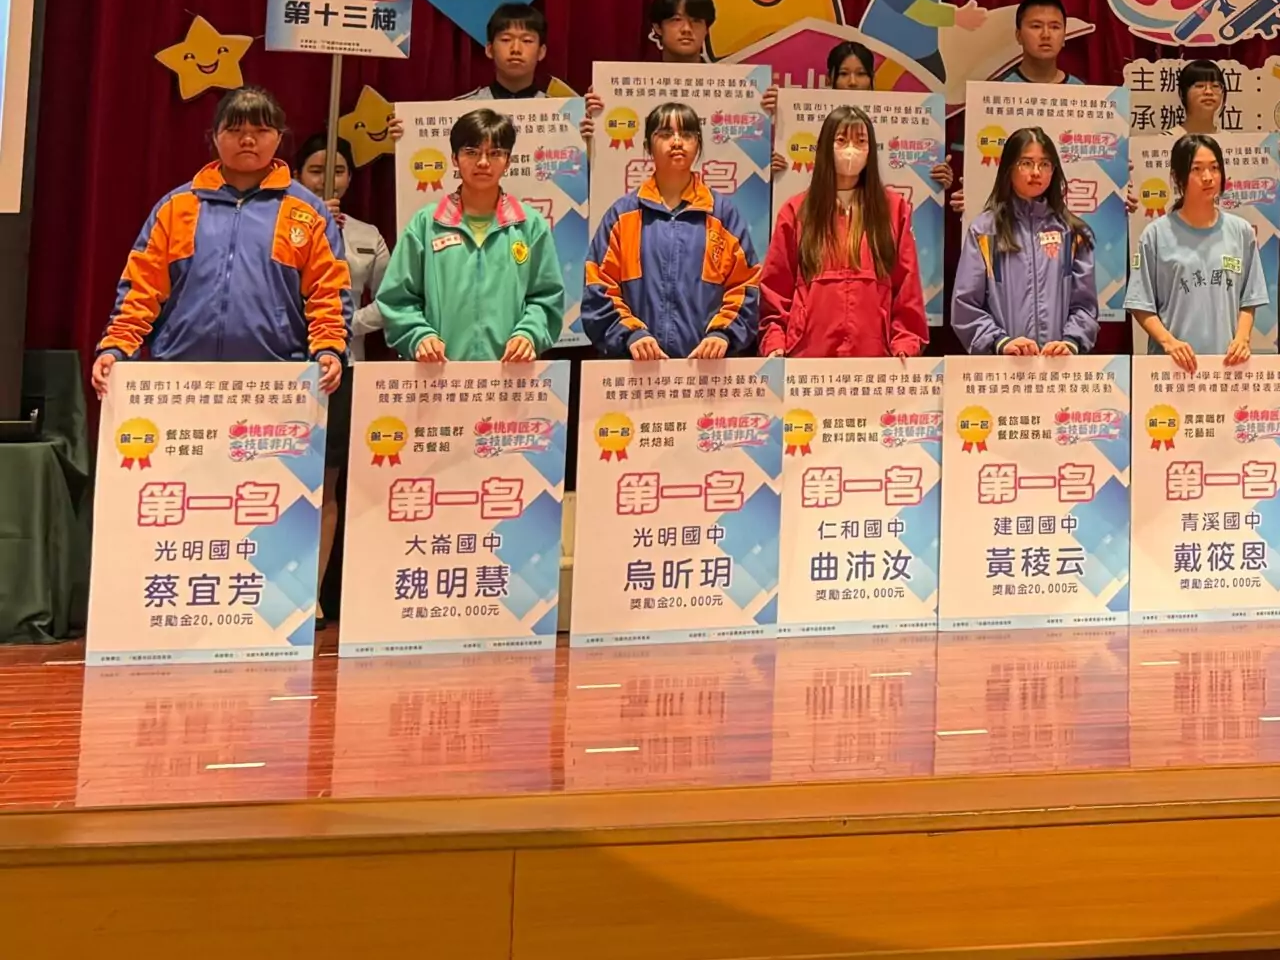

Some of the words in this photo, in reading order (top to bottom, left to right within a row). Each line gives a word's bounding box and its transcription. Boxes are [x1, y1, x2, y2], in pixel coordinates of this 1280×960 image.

[284, 0, 397, 31] 第十三梯
[1131, 67, 1262, 93] 主辦位：
[1130, 105, 1262, 131] 承辦位：
[126, 380, 311, 391] 桃園市114學年度國中技藝教育
[375, 378, 552, 390] 桃園市114學年度國中技藝教育
[602, 374, 769, 387] 桃園市114學年度國中技藝教育
[786, 373, 944, 384] 桃園市114學年度國中技藝教育
[963, 371, 1115, 382] 桃園市114學年度國中技藝教育
[129, 394, 307, 405] 競賽頒獎典禮暨成果發表活動
[378, 392, 548, 403] 競賽頒獎典禮暨成果發表活動
[606, 387, 766, 400] 競賽頒獎典禮暨成果發表活動
[790, 385, 941, 397] 競賽頒獎典禮暨成果發表活動
[966, 383, 1112, 394] 競賽頒獎典禮暨成果發表活動
[165, 445, 204, 456] 中餐組
[413, 442, 450, 453] 西餐組
[801, 465, 923, 508] 第一名
[978, 463, 1095, 504] 第一名
[1166, 460, 1277, 501] 第一名
[388, 477, 524, 522] 第一名
[617, 470, 744, 515] 第一名
[138, 481, 280, 527] 第一名
[817, 517, 905, 540] 仁和國中
[993, 514, 1079, 536] 建國國中
[1181, 511, 1262, 532] 青溪國中
[404, 533, 502, 556] 大崙國中
[632, 525, 725, 548] 光明國中
[154, 539, 257, 562] 光明國中
[1173, 541, 1268, 573] 戴筱恩
[810, 549, 913, 582] 曲沛汝
[986, 546, 1086, 579] 黃稜云
[394, 565, 509, 601] 魏明慧
[623, 556, 732, 592] 烏昕玥
[1180, 576, 1262, 590] 獎勵金20,000元
[143, 572, 264, 608] 蔡宜芳
[815, 586, 905, 602] 獎勵金20,000元
[992, 581, 1079, 596] 獎勵金20,000元
[401, 604, 500, 619] 獎勵金20,000元
[630, 594, 723, 610] 獎勵金20,000元
[150, 613, 254, 628] 獎勵金20,000元
